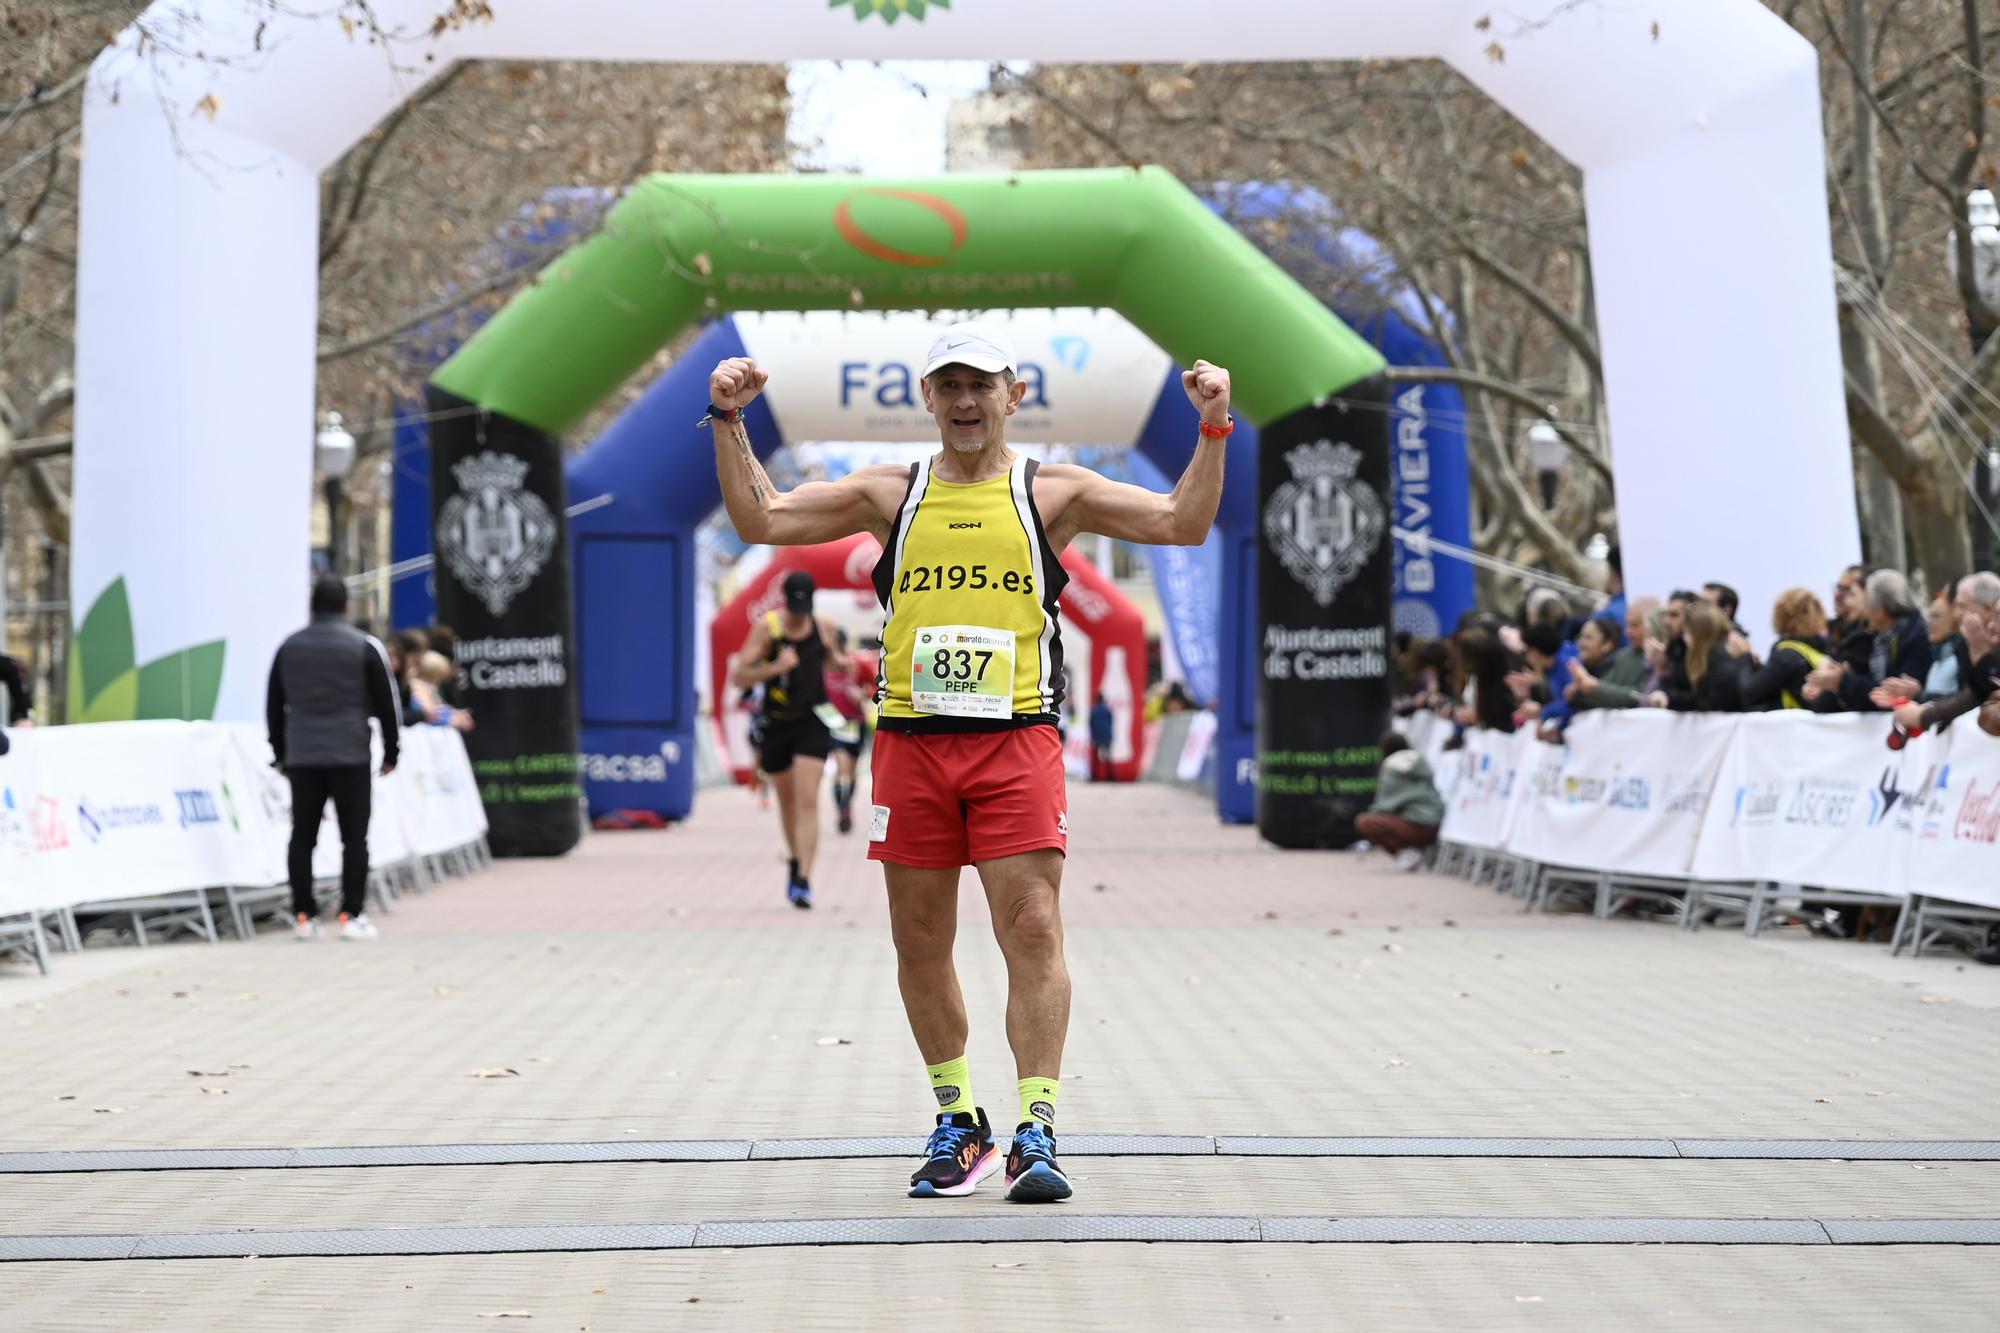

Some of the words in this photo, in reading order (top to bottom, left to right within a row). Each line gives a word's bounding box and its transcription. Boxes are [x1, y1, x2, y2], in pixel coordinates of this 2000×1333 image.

[840, 362, 1048, 408] Faa
[1397, 384, 1434, 592] BAVIERA
[899, 565, 1034, 595] 42195.es
[933, 649, 993, 681] 837
[946, 681, 977, 693] PEPE
